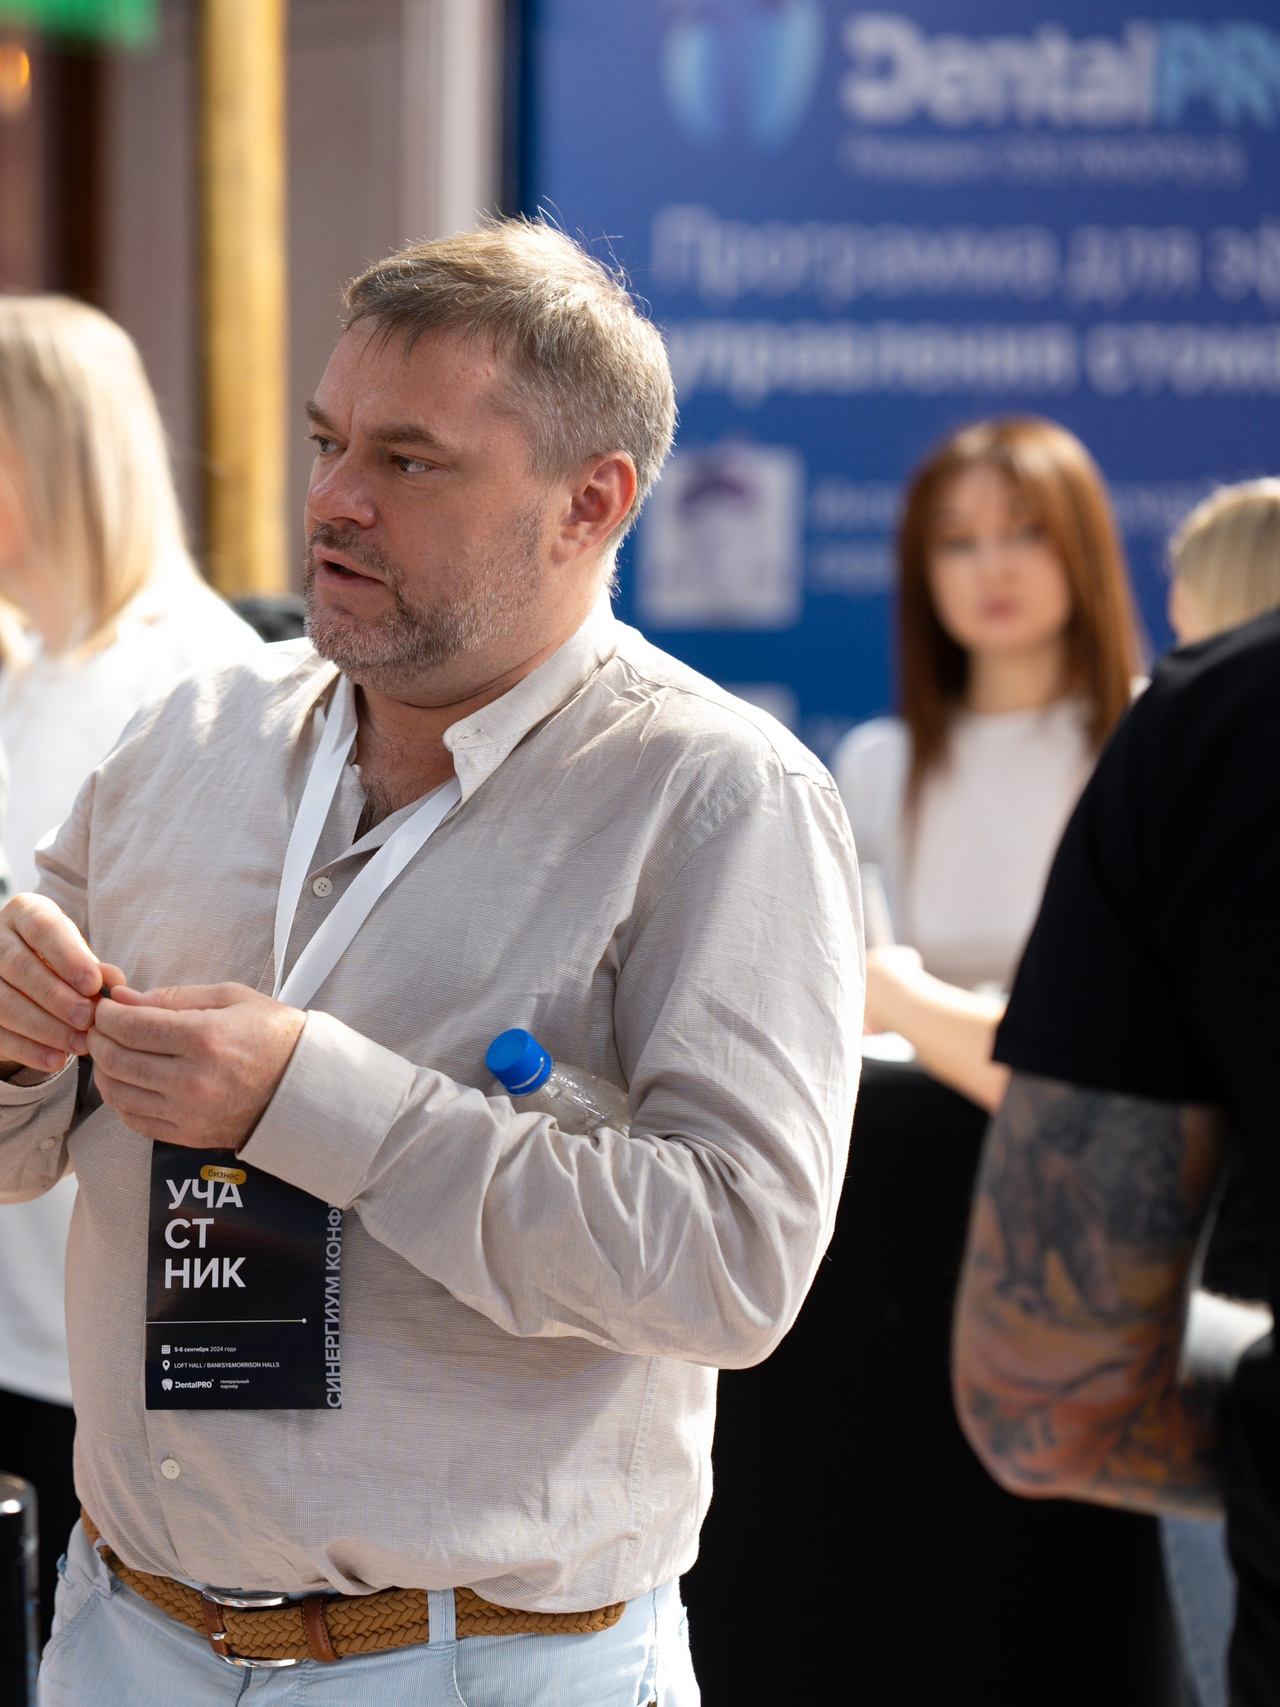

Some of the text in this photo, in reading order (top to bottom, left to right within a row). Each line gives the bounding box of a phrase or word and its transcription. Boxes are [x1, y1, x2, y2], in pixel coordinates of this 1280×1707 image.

[207, 1168, 241, 1182] бизнес
[165, 1178, 244, 1210] УЧА
[164, 1217, 215, 1250] СТ
[164, 1256, 247, 1289] НИК
[324, 1203, 343, 1409] СИНЕРГИУМ КОНФ
[207, 1361, 262, 1369] BANKSY&MORRISON
